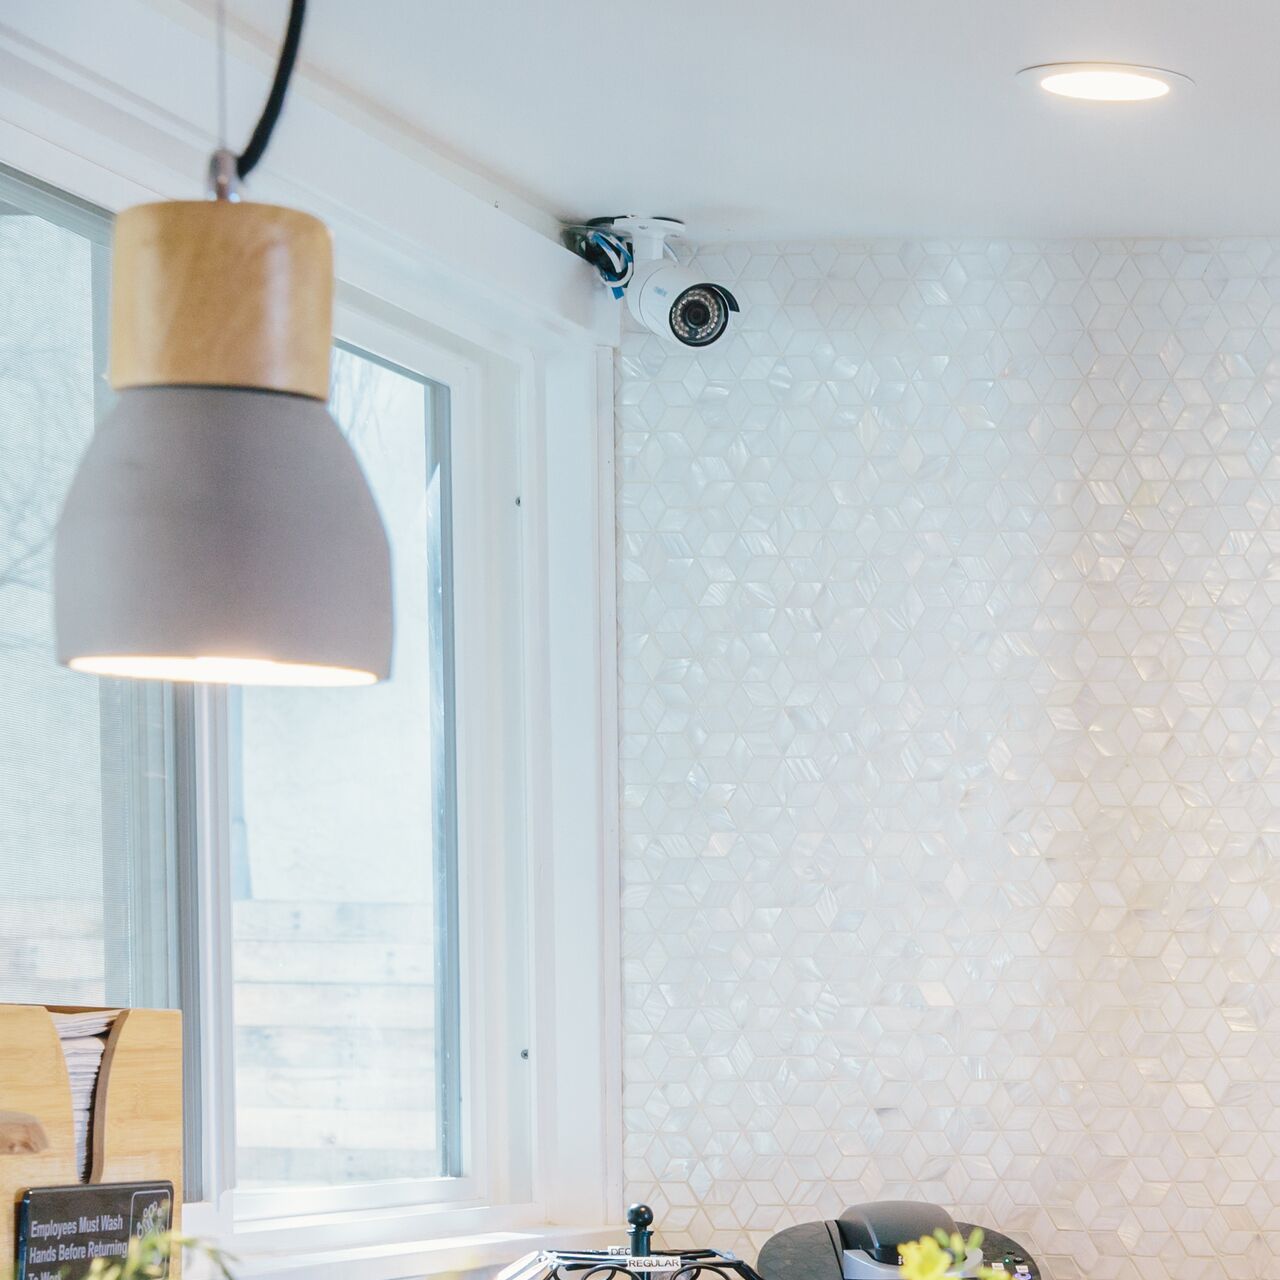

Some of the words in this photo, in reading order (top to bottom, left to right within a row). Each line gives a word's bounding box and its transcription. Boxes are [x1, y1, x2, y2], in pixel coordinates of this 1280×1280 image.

[31, 1220, 77, 1240] Employees
[79, 1216, 99, 1233] Must
[101, 1214, 123, 1231] Wash
[29, 1246, 56, 1264] Hands
[59, 1243, 86, 1260] Before
[88, 1240, 128, 1258] Returning
[610, 1247, 631, 1256] DEC
[628, 1259, 679, 1268] REGULAR
